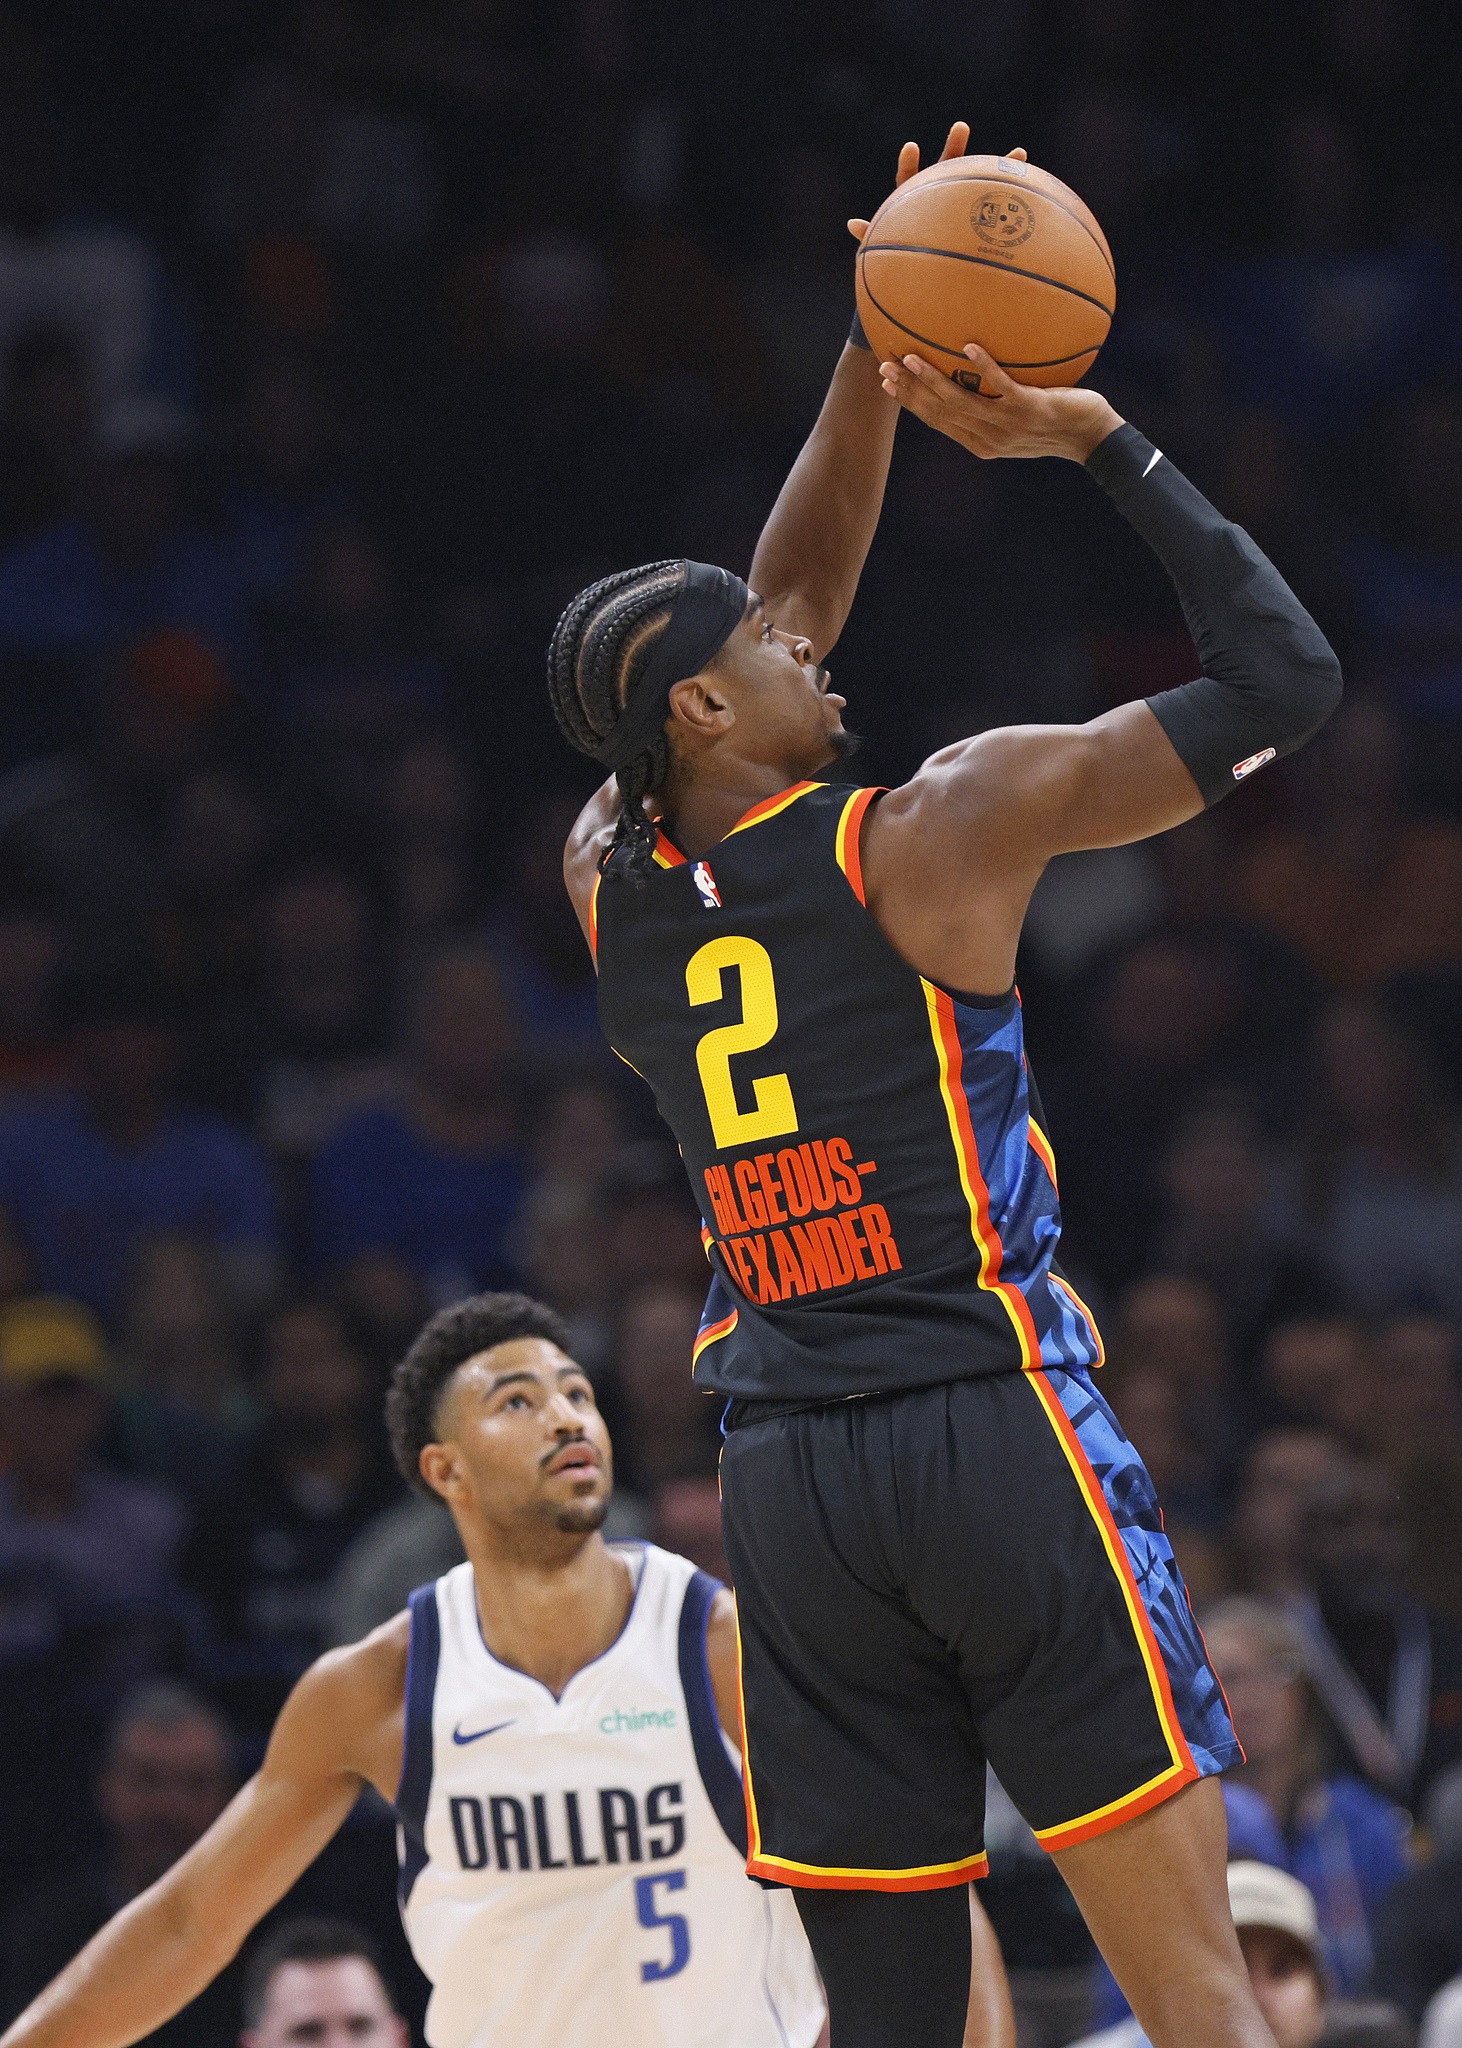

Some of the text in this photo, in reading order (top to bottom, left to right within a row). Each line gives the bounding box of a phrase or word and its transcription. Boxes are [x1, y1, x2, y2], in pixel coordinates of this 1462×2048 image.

[685, 935, 799, 1150] 2
[703, 1136, 878, 1237] GILGEOUS-
[717, 1203, 903, 1305] LEXANDER
[600, 1706, 677, 1734] chime
[449, 1781, 686, 1871] DALLAS
[634, 1869, 691, 1984] 5
